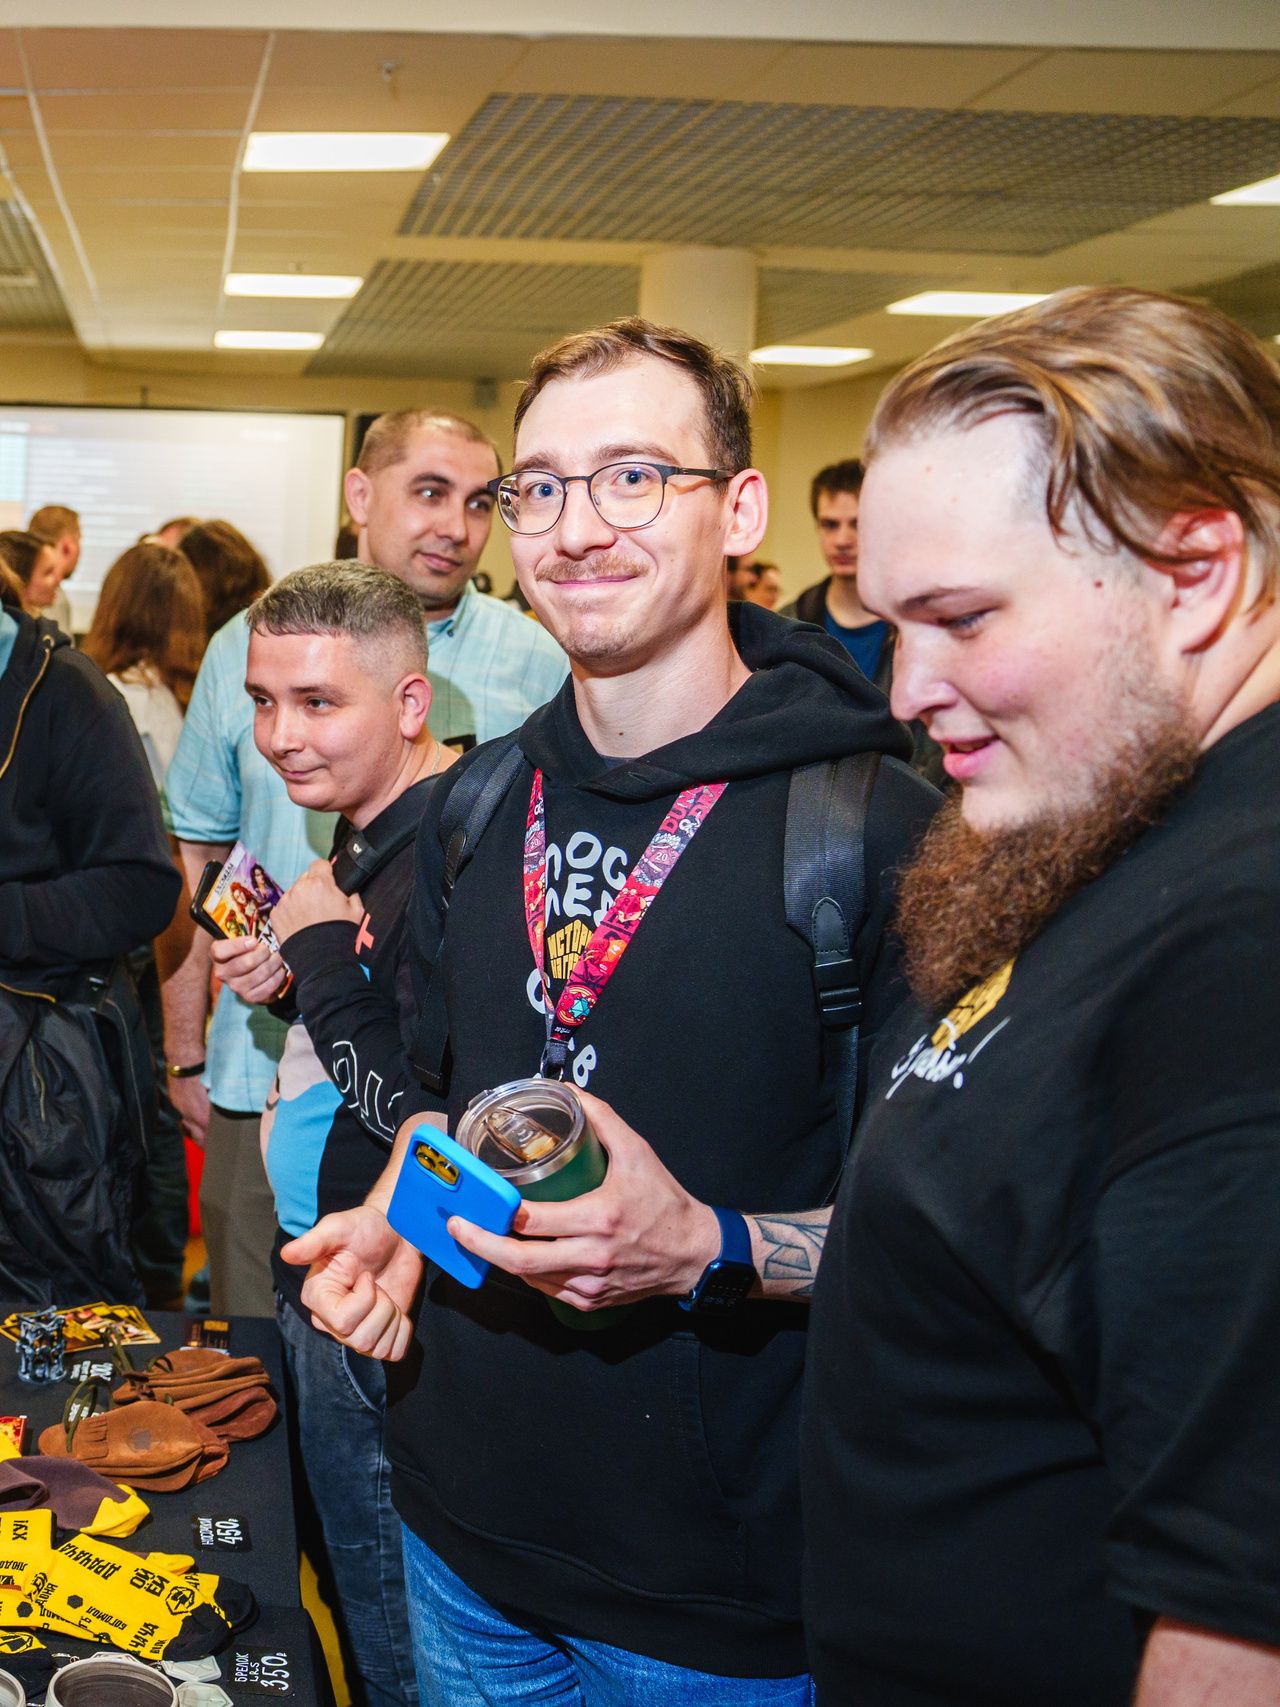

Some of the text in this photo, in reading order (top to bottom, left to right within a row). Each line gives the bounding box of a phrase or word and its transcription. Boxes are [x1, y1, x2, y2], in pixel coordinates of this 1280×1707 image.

[654, 851, 669, 862] 20
[58, 1542, 122, 1580] ДРАЧАЧА
[86, 1604, 128, 1631] БОГОМОЛ
[234, 1652, 250, 1682] БРЕЛОК
[249, 1662, 260, 1682] LRS
